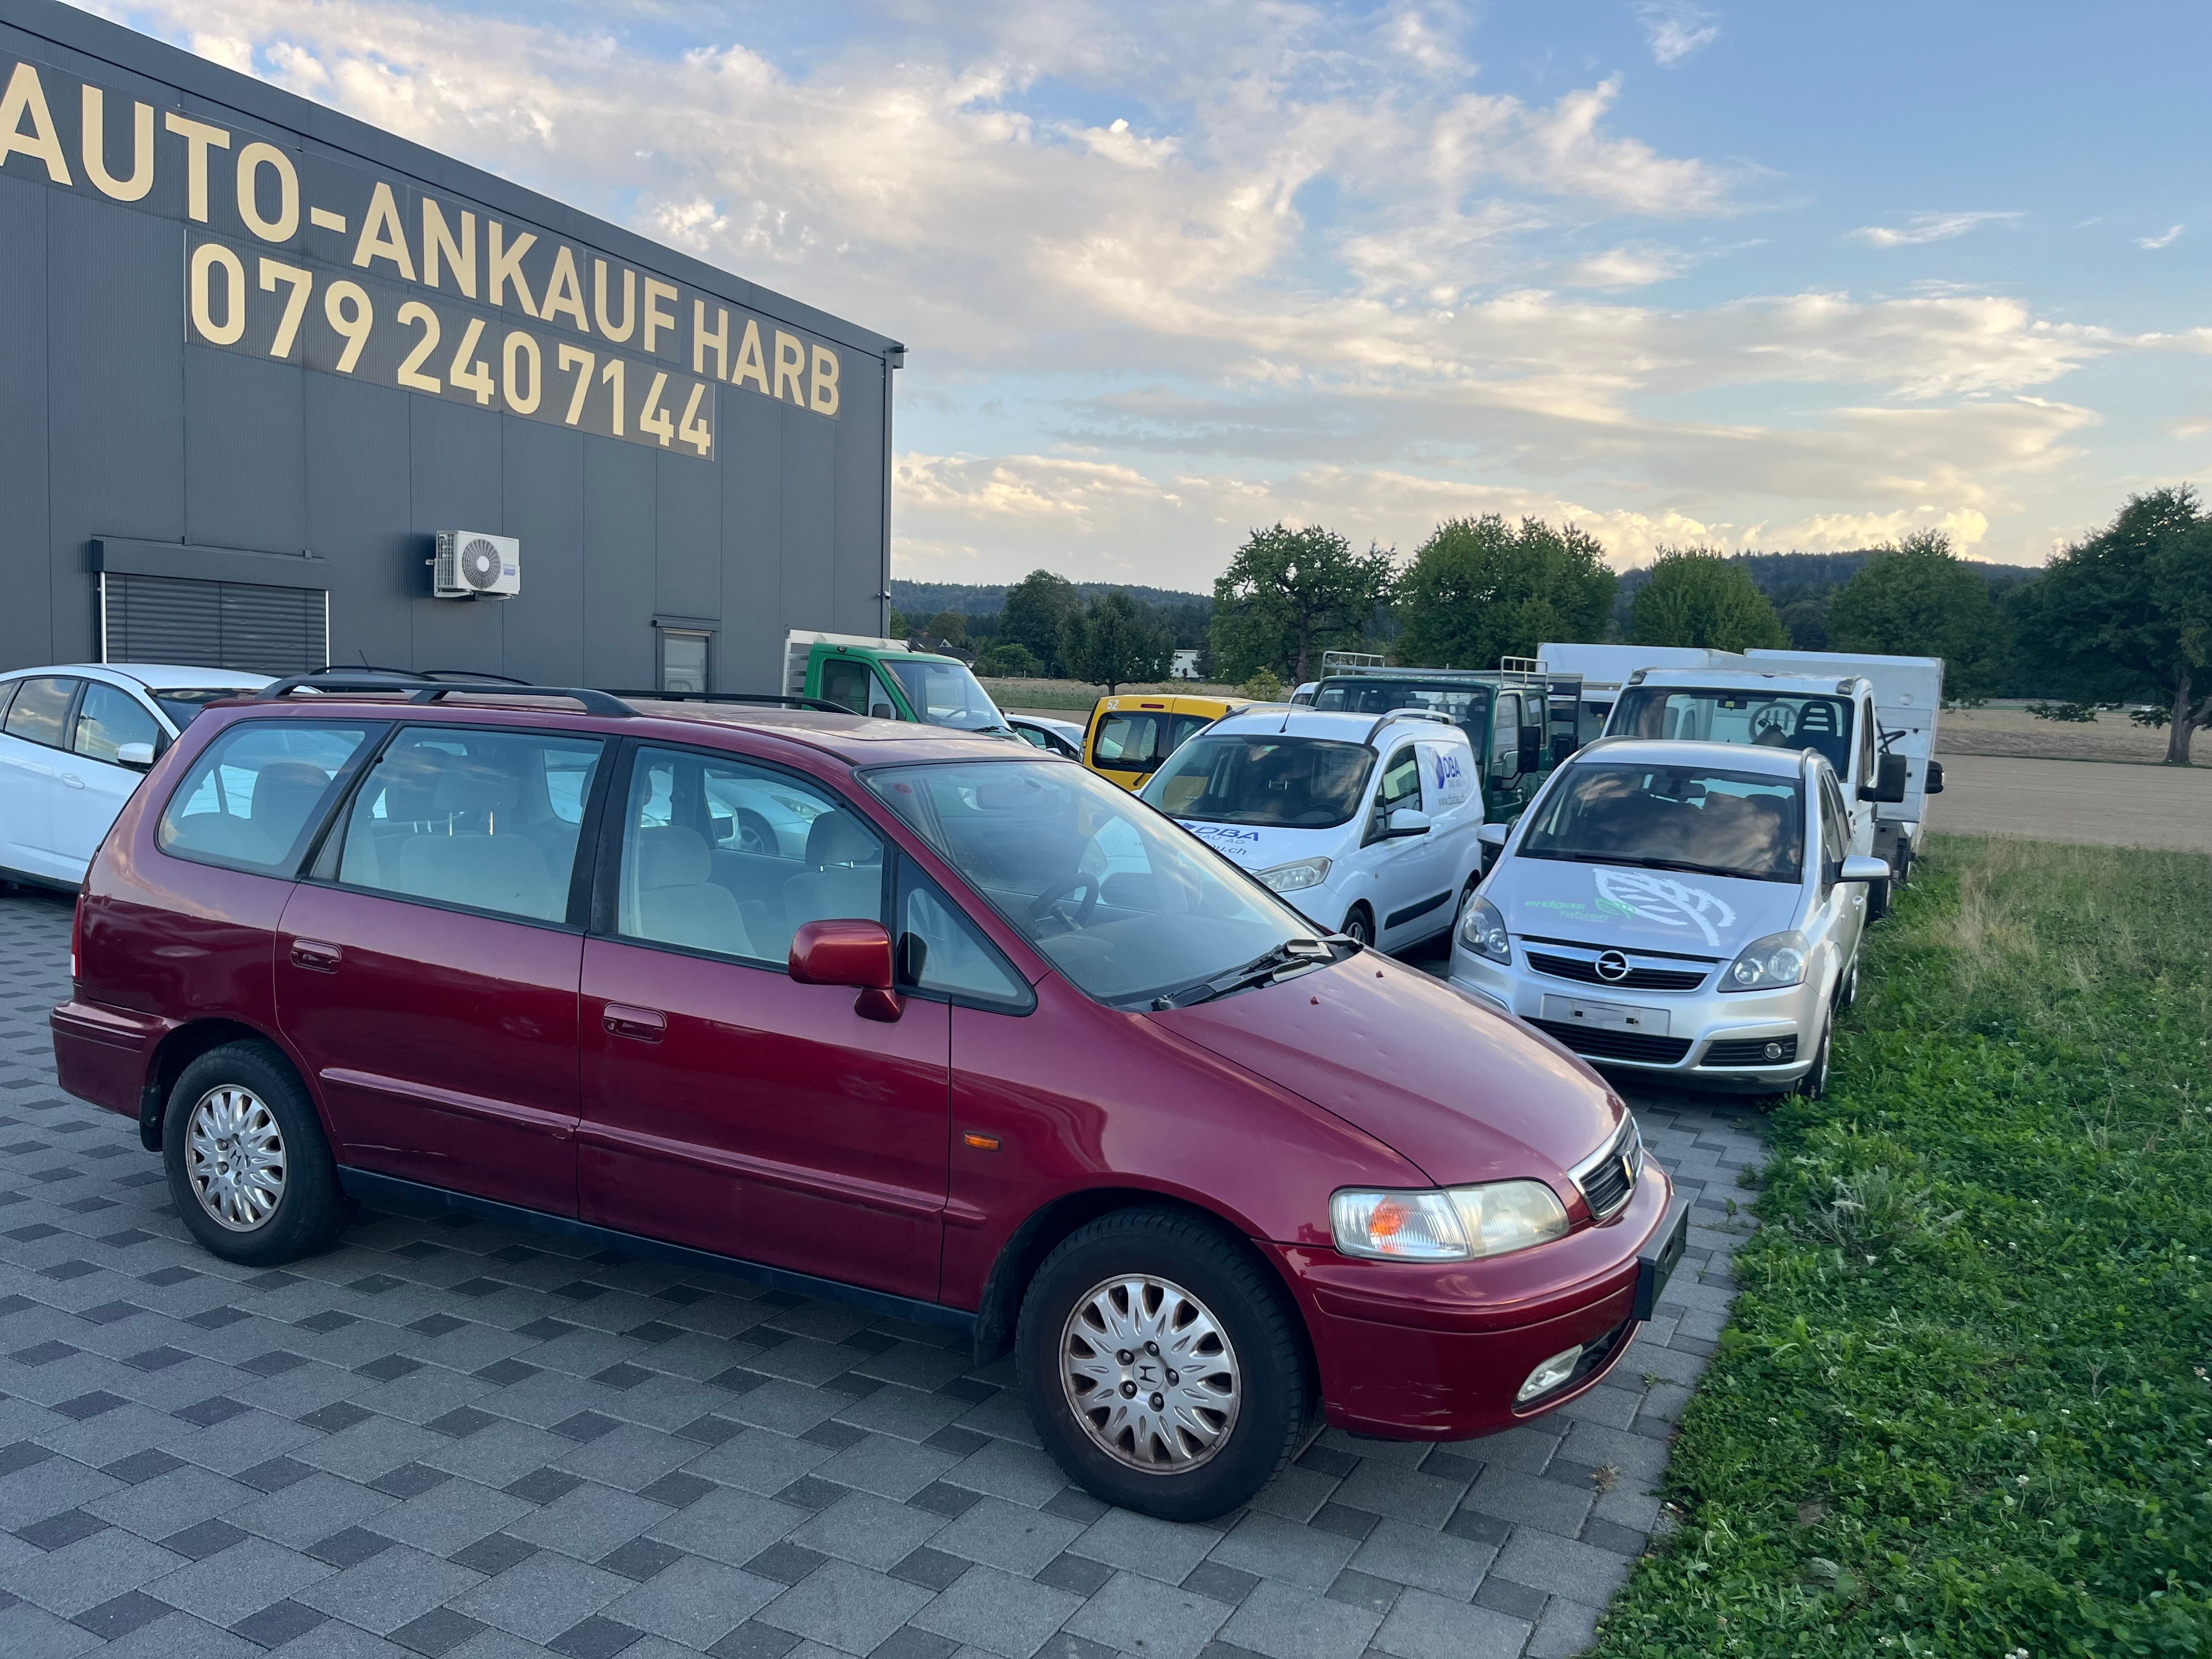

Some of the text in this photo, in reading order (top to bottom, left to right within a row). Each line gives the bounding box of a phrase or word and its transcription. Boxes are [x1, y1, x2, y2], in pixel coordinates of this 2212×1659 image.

[0, 62, 840, 416] AUTO-ANKAUF HARB
[191, 243, 373, 374] 079
[397, 301, 541, 415] 240
[1107, 699, 1119, 710] 52
[1442, 757, 1462, 778] DBA
[1194, 827, 1259, 842] DBA
[1525, 900, 1585, 910] erdgas
